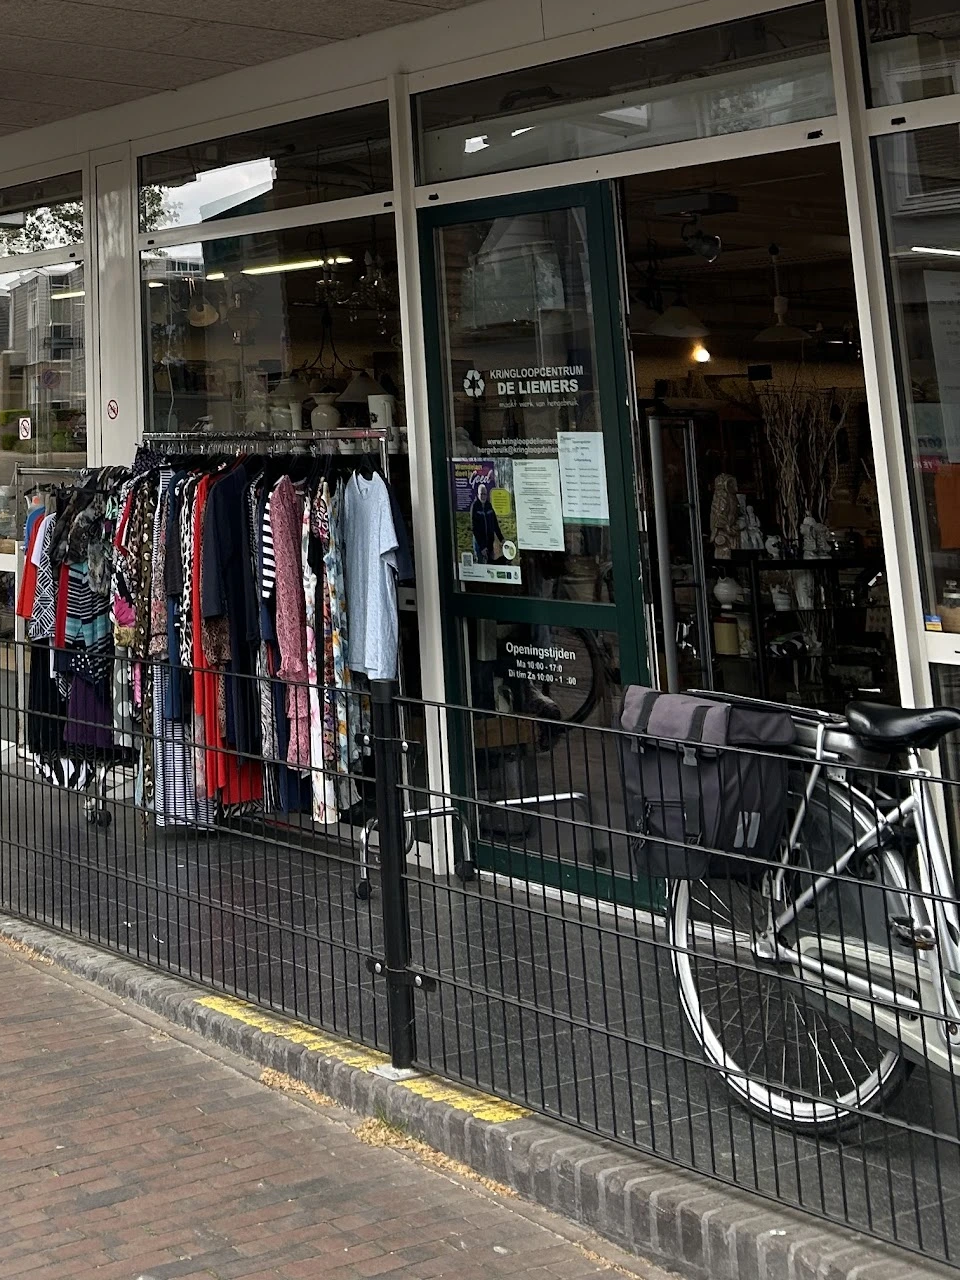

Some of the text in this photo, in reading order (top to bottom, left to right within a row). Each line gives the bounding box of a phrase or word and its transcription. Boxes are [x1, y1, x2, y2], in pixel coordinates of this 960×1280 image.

[490, 365, 584, 380] KRINGLOOPCENTRUM
[497, 379, 579, 395] DE LIEMERS
[505, 641, 576, 661] Openingstijden
[516, 659, 526, 669] Ma
[527, 660, 544, 670] 10:00
[508, 669, 516, 677] Di
[527, 671, 536, 680] Za
[537, 673, 554, 683] 10:00
